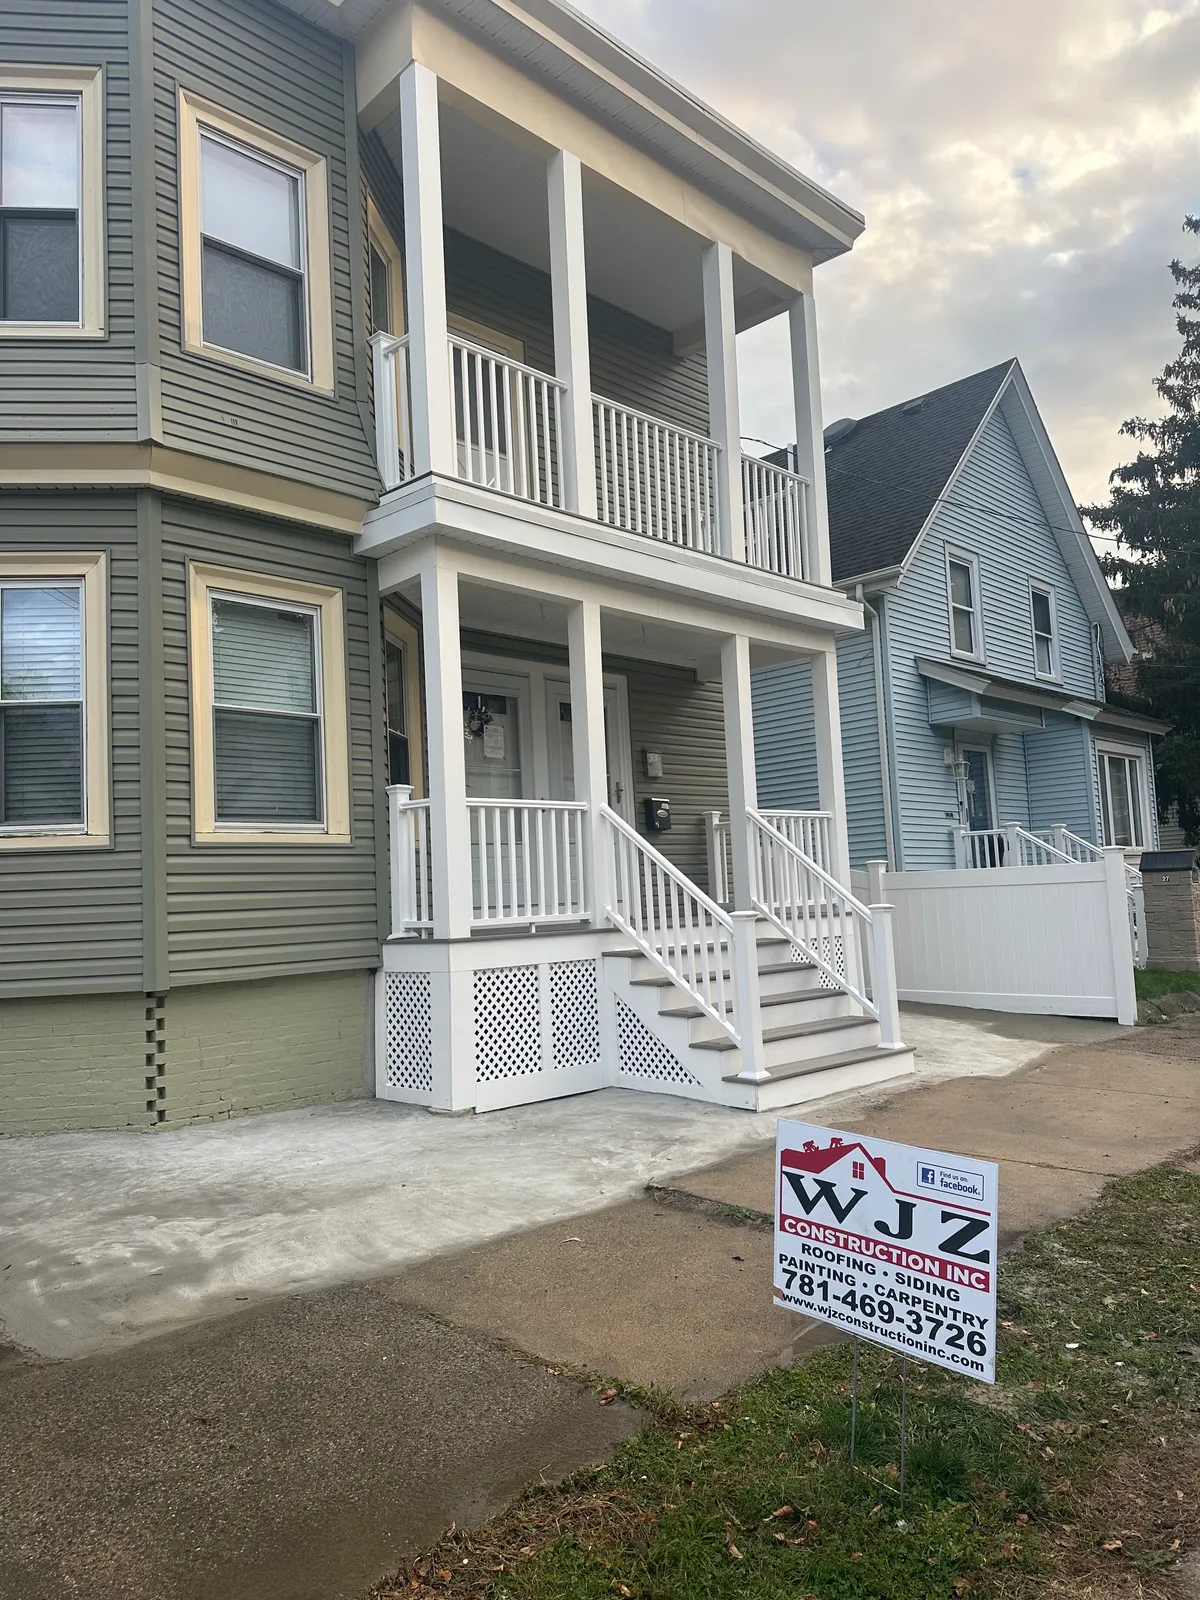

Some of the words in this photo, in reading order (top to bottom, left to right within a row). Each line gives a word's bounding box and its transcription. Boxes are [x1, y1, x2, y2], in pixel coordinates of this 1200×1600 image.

[779, 1253, 856, 1286] PAINTING
[874, 1284, 989, 1330] CARPENTRY
[784, 1218, 939, 1276] CONSTRUCTION
[947, 1264, 986, 1289] INC
[801, 1243, 876, 1275] ROOFING
[895, 1272, 960, 1302] SIDING
[782, 1268, 987, 1357] 781-469-3726
[783, 1293, 984, 1372] www.wjzconstructioninc.com
